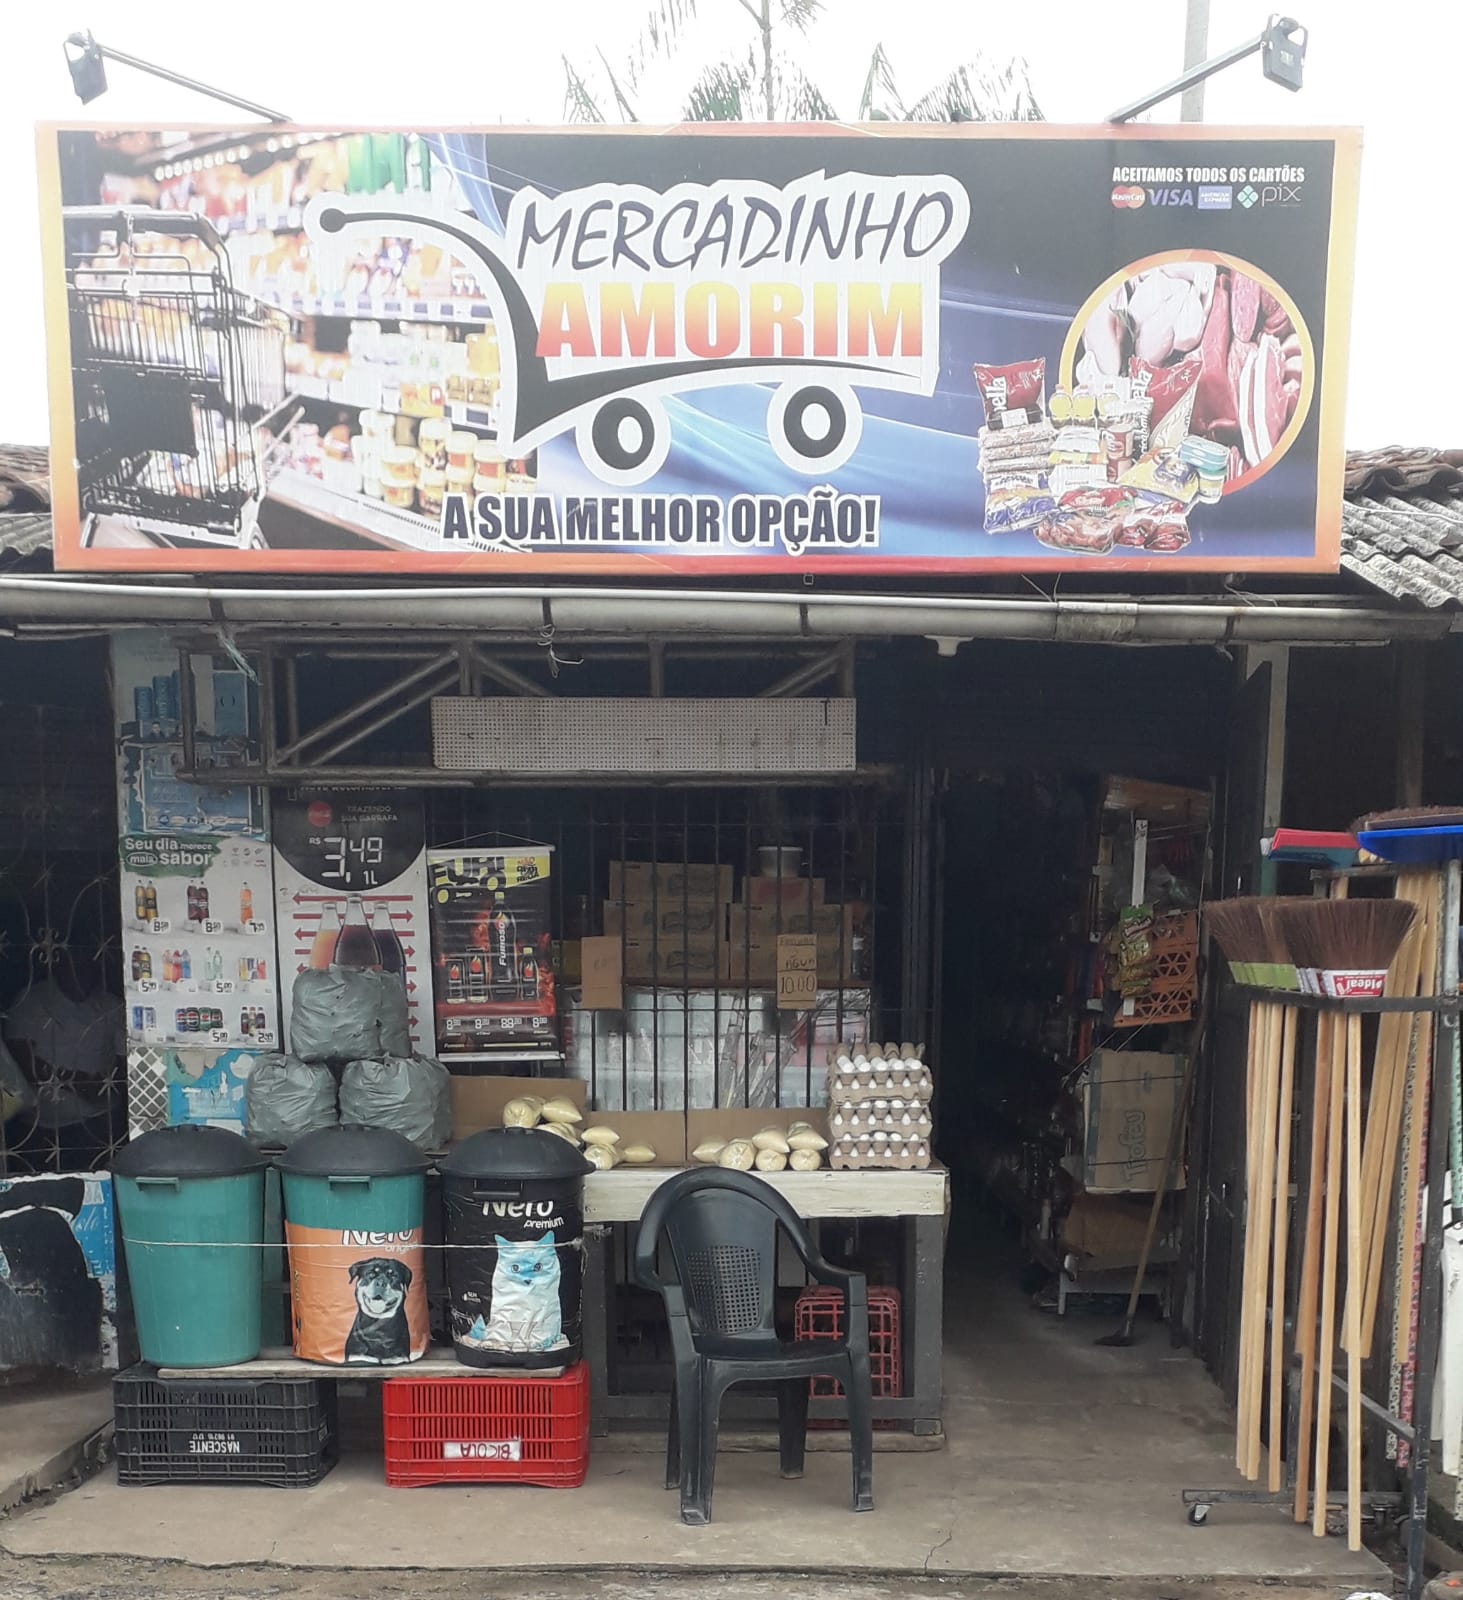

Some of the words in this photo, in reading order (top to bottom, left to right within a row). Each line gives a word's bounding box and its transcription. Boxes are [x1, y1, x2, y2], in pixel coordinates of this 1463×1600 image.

[1112, 167, 1183, 183] ACEITAMOS
[1186, 167, 1228, 183] TODOS
[1229, 167, 1247, 183] OS
[1249, 164, 1305, 182] CARTÕES
[1149, 188, 1194, 206] VISA
[1261, 184, 1302, 207] pix
[517, 190, 954, 272] MERCADINHO
[535, 281, 923, 358] AMORIM
[443, 496, 469, 540] A
[477, 496, 557, 541] SUA
[565, 496, 720, 542] MELHOR
[730, 490, 877, 552] OPÇÃO!
[124, 838, 153, 850] Seu
[155, 838, 178, 850] dia
[159, 852, 212, 865] sabor
[363, 870, 378, 885] 1L
[523, 1216, 564, 1229] premium
[189, 1440, 240, 1453] NASCENTE
